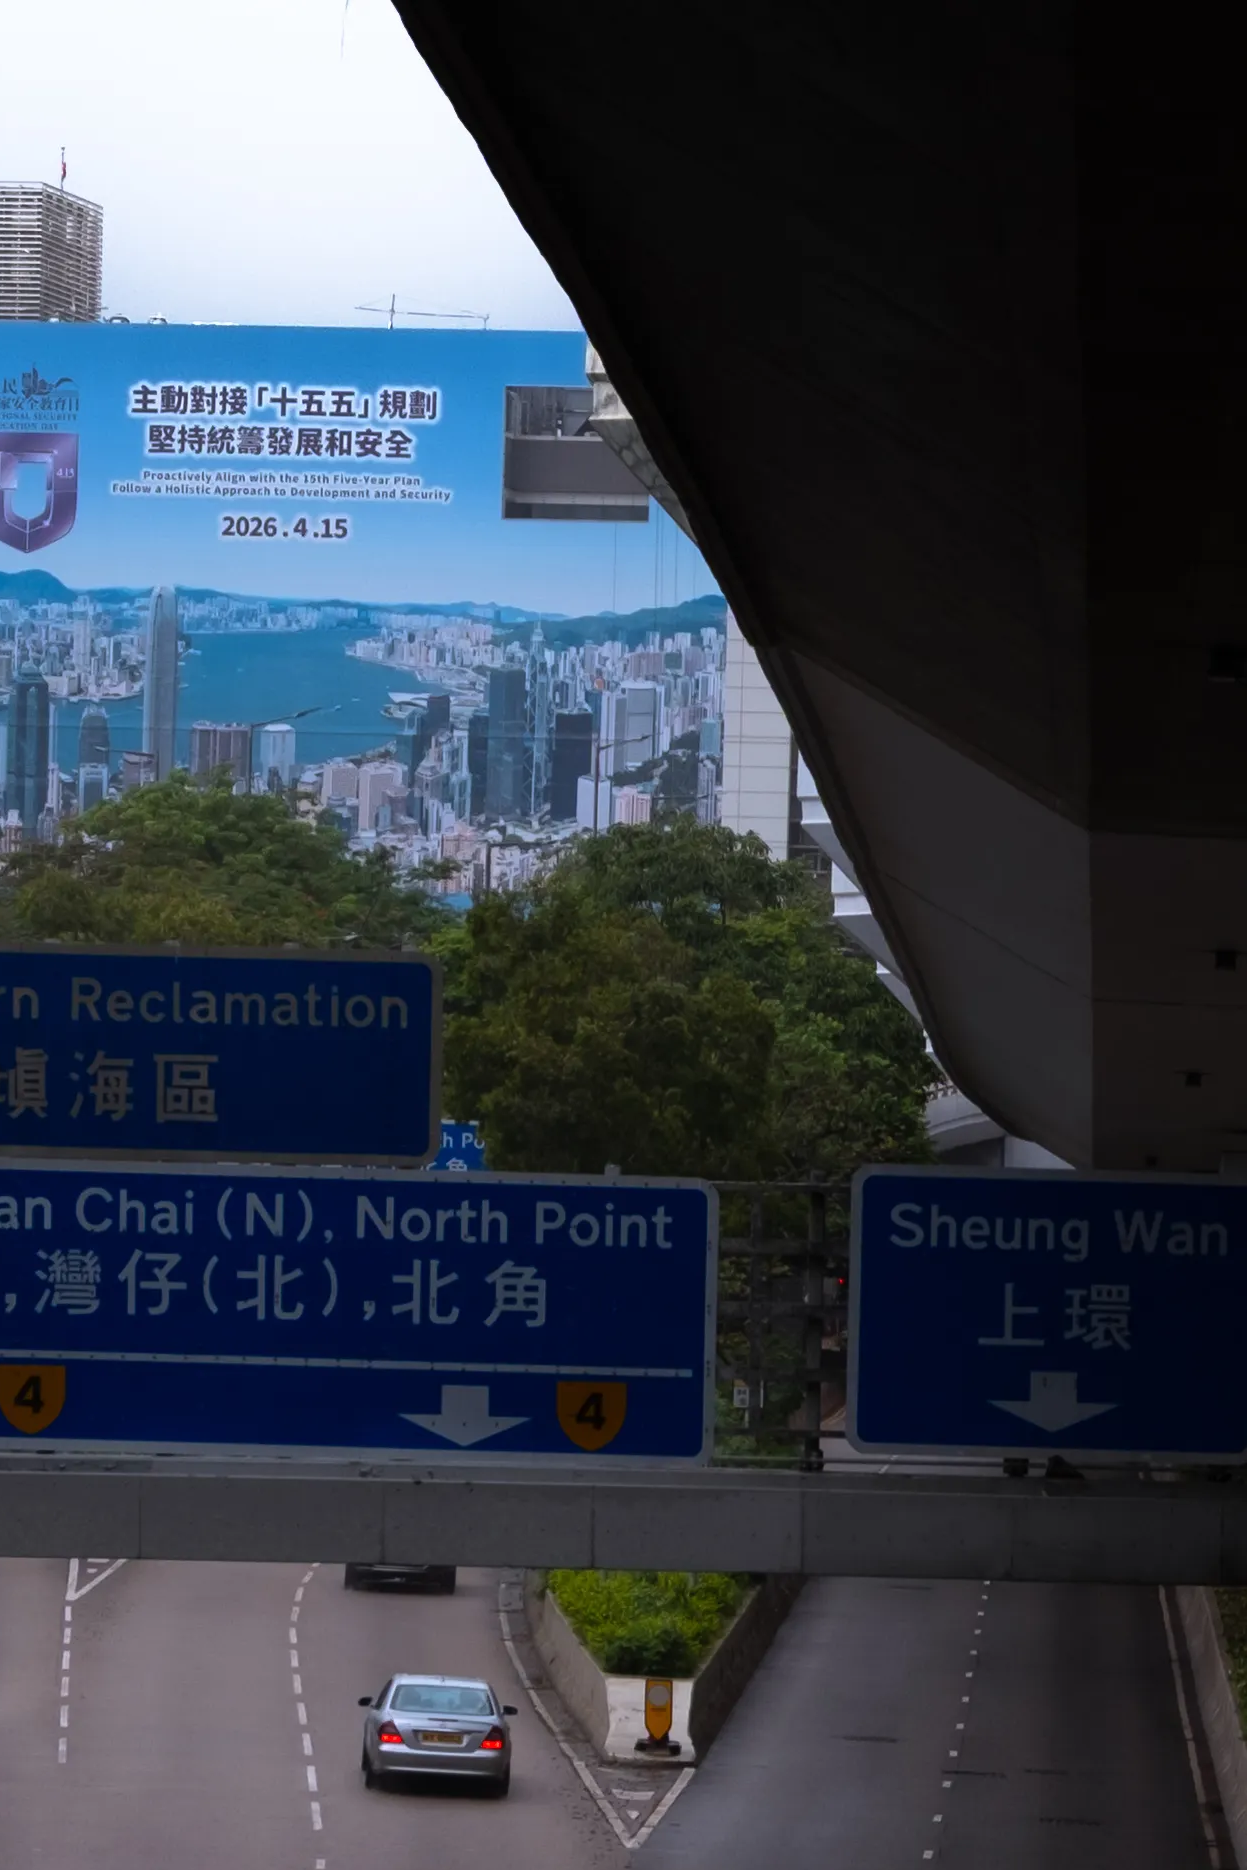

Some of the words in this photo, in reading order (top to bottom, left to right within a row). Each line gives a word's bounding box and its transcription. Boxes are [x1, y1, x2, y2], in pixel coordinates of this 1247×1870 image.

[131, 385, 438, 420] 主動對接「十五五」規劃
[147, 425, 414, 459] 堅持統籌發展和安全
[112, 483, 152, 493] Follow
[165, 484, 211, 495] Holistic
[214, 486, 271, 496] Approach
[274, 486, 286, 496] to
[290, 487, 370, 499] Development
[374, 488, 397, 499] and
[400, 489, 451, 502] Security
[143, 471, 212, 483] Proactively
[215, 472, 246, 484] Align
[250, 472, 276, 483] with
[280, 474, 299, 483] the
[304, 475, 330, 484] 15th
[333, 474, 391, 485] Five-Year
[394, 476, 421, 486] Plan
[69, 976, 410, 1030] Reclamation
[75, 1186, 196, 1236] Chai
[216, 1186, 334, 1244] (N),
[356, 1195, 510, 1244] North
[534, 1201, 675, 1250] Point
[888, 1201, 1092, 1263] Sheung
[1112, 1208, 1229, 1257] Wan
[977, 1281, 1134, 1352] 上環
[13, 1375, 45, 1415] 4
[575, 1392, 606, 1431] 4
